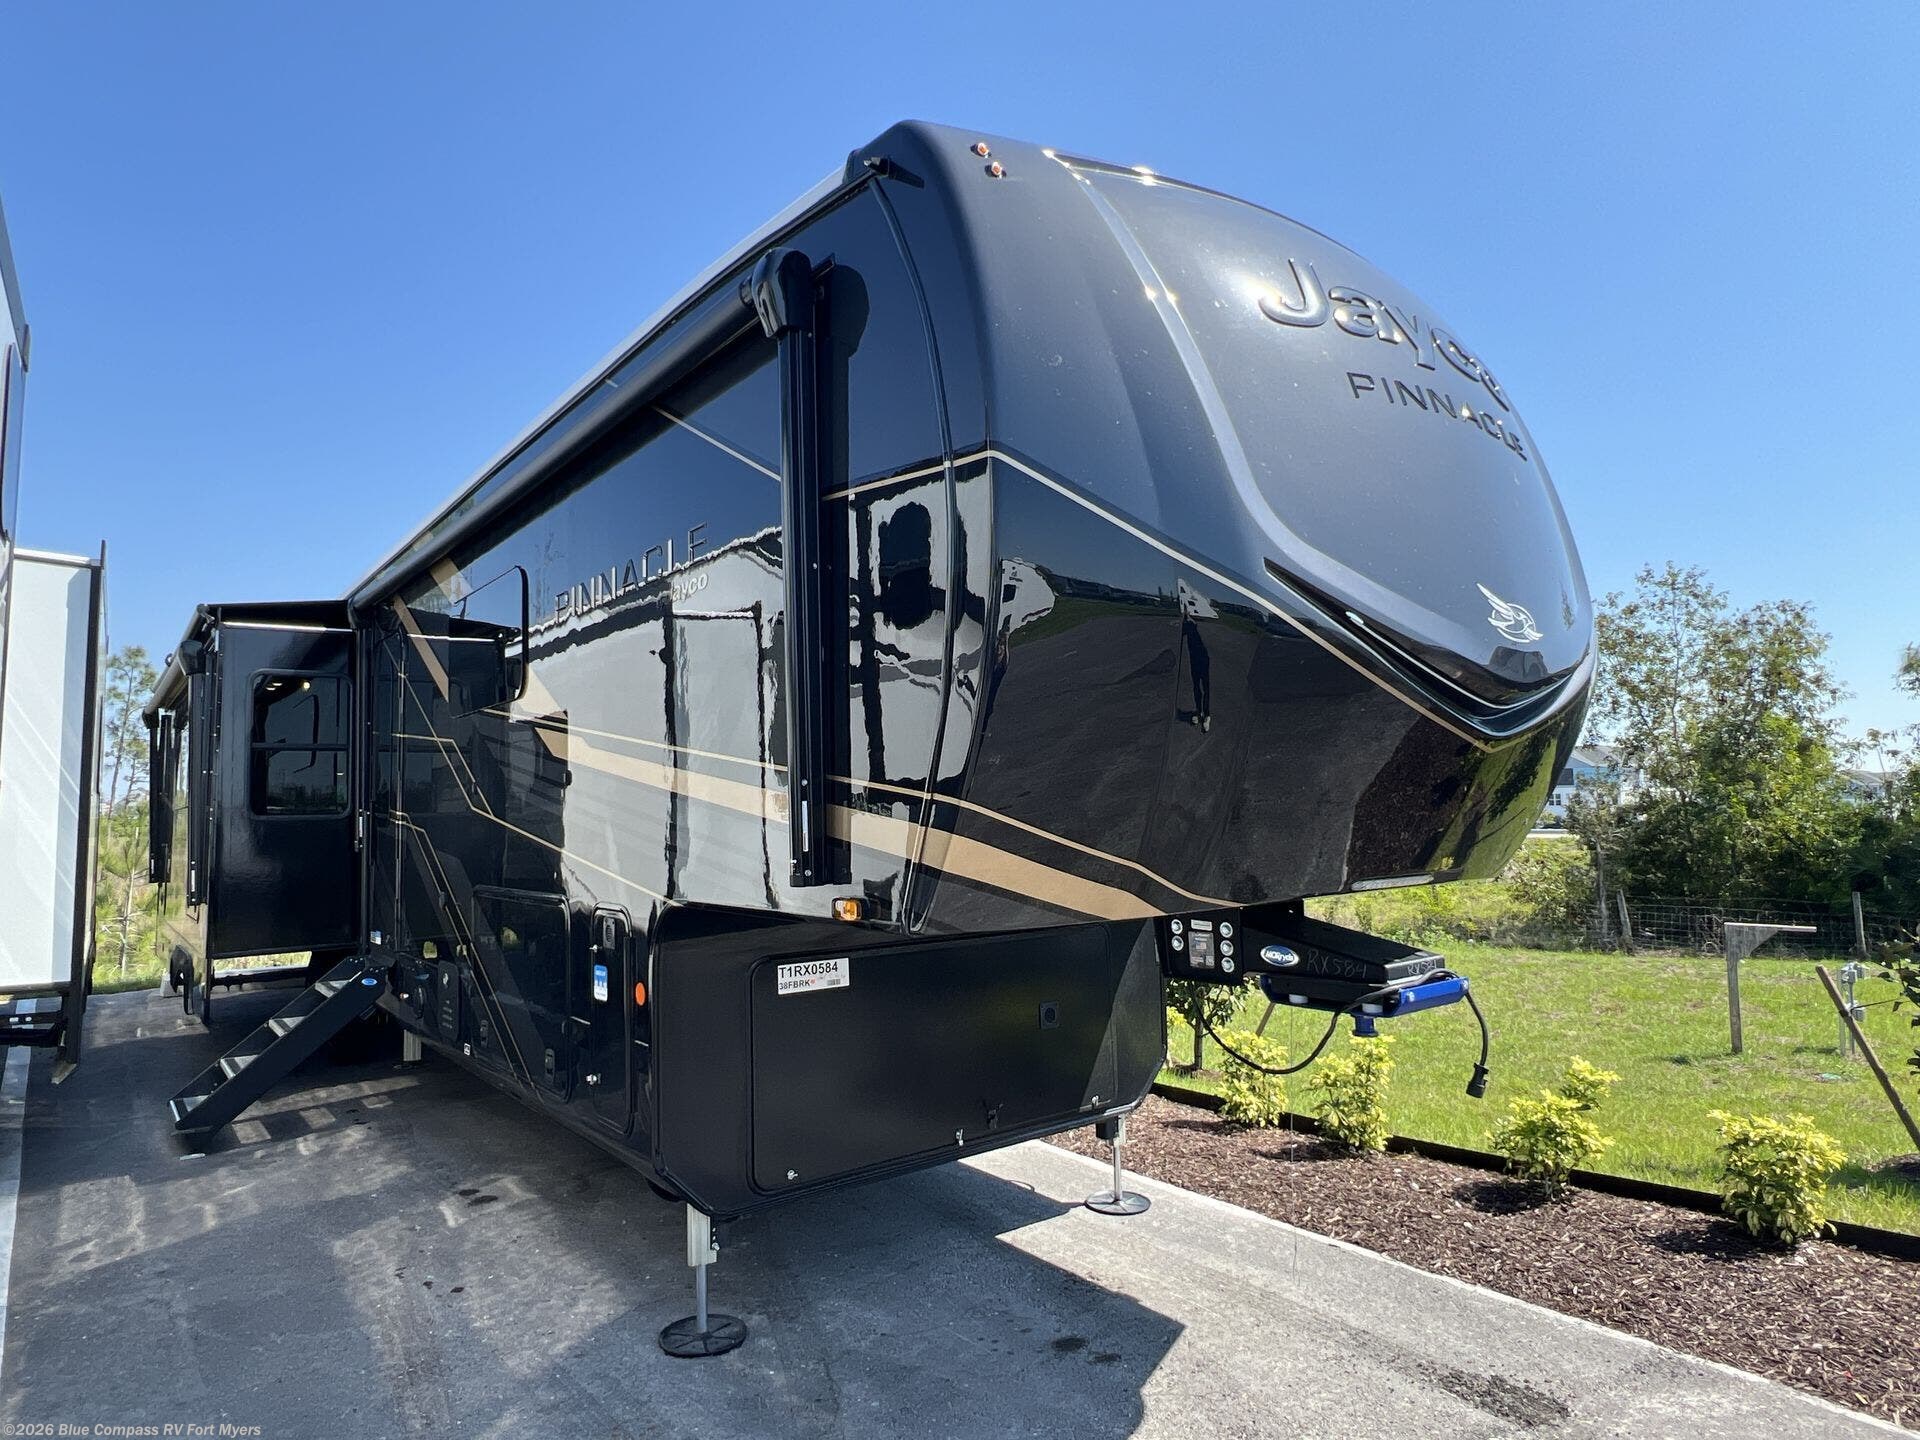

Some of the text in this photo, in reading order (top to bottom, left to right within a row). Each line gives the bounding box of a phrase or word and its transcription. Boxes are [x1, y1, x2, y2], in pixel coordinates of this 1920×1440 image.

[1346, 371, 1528, 462] PINNACLE
[779, 961, 838, 979] T1RX0584
[779, 979, 811, 990] 38FBRK
